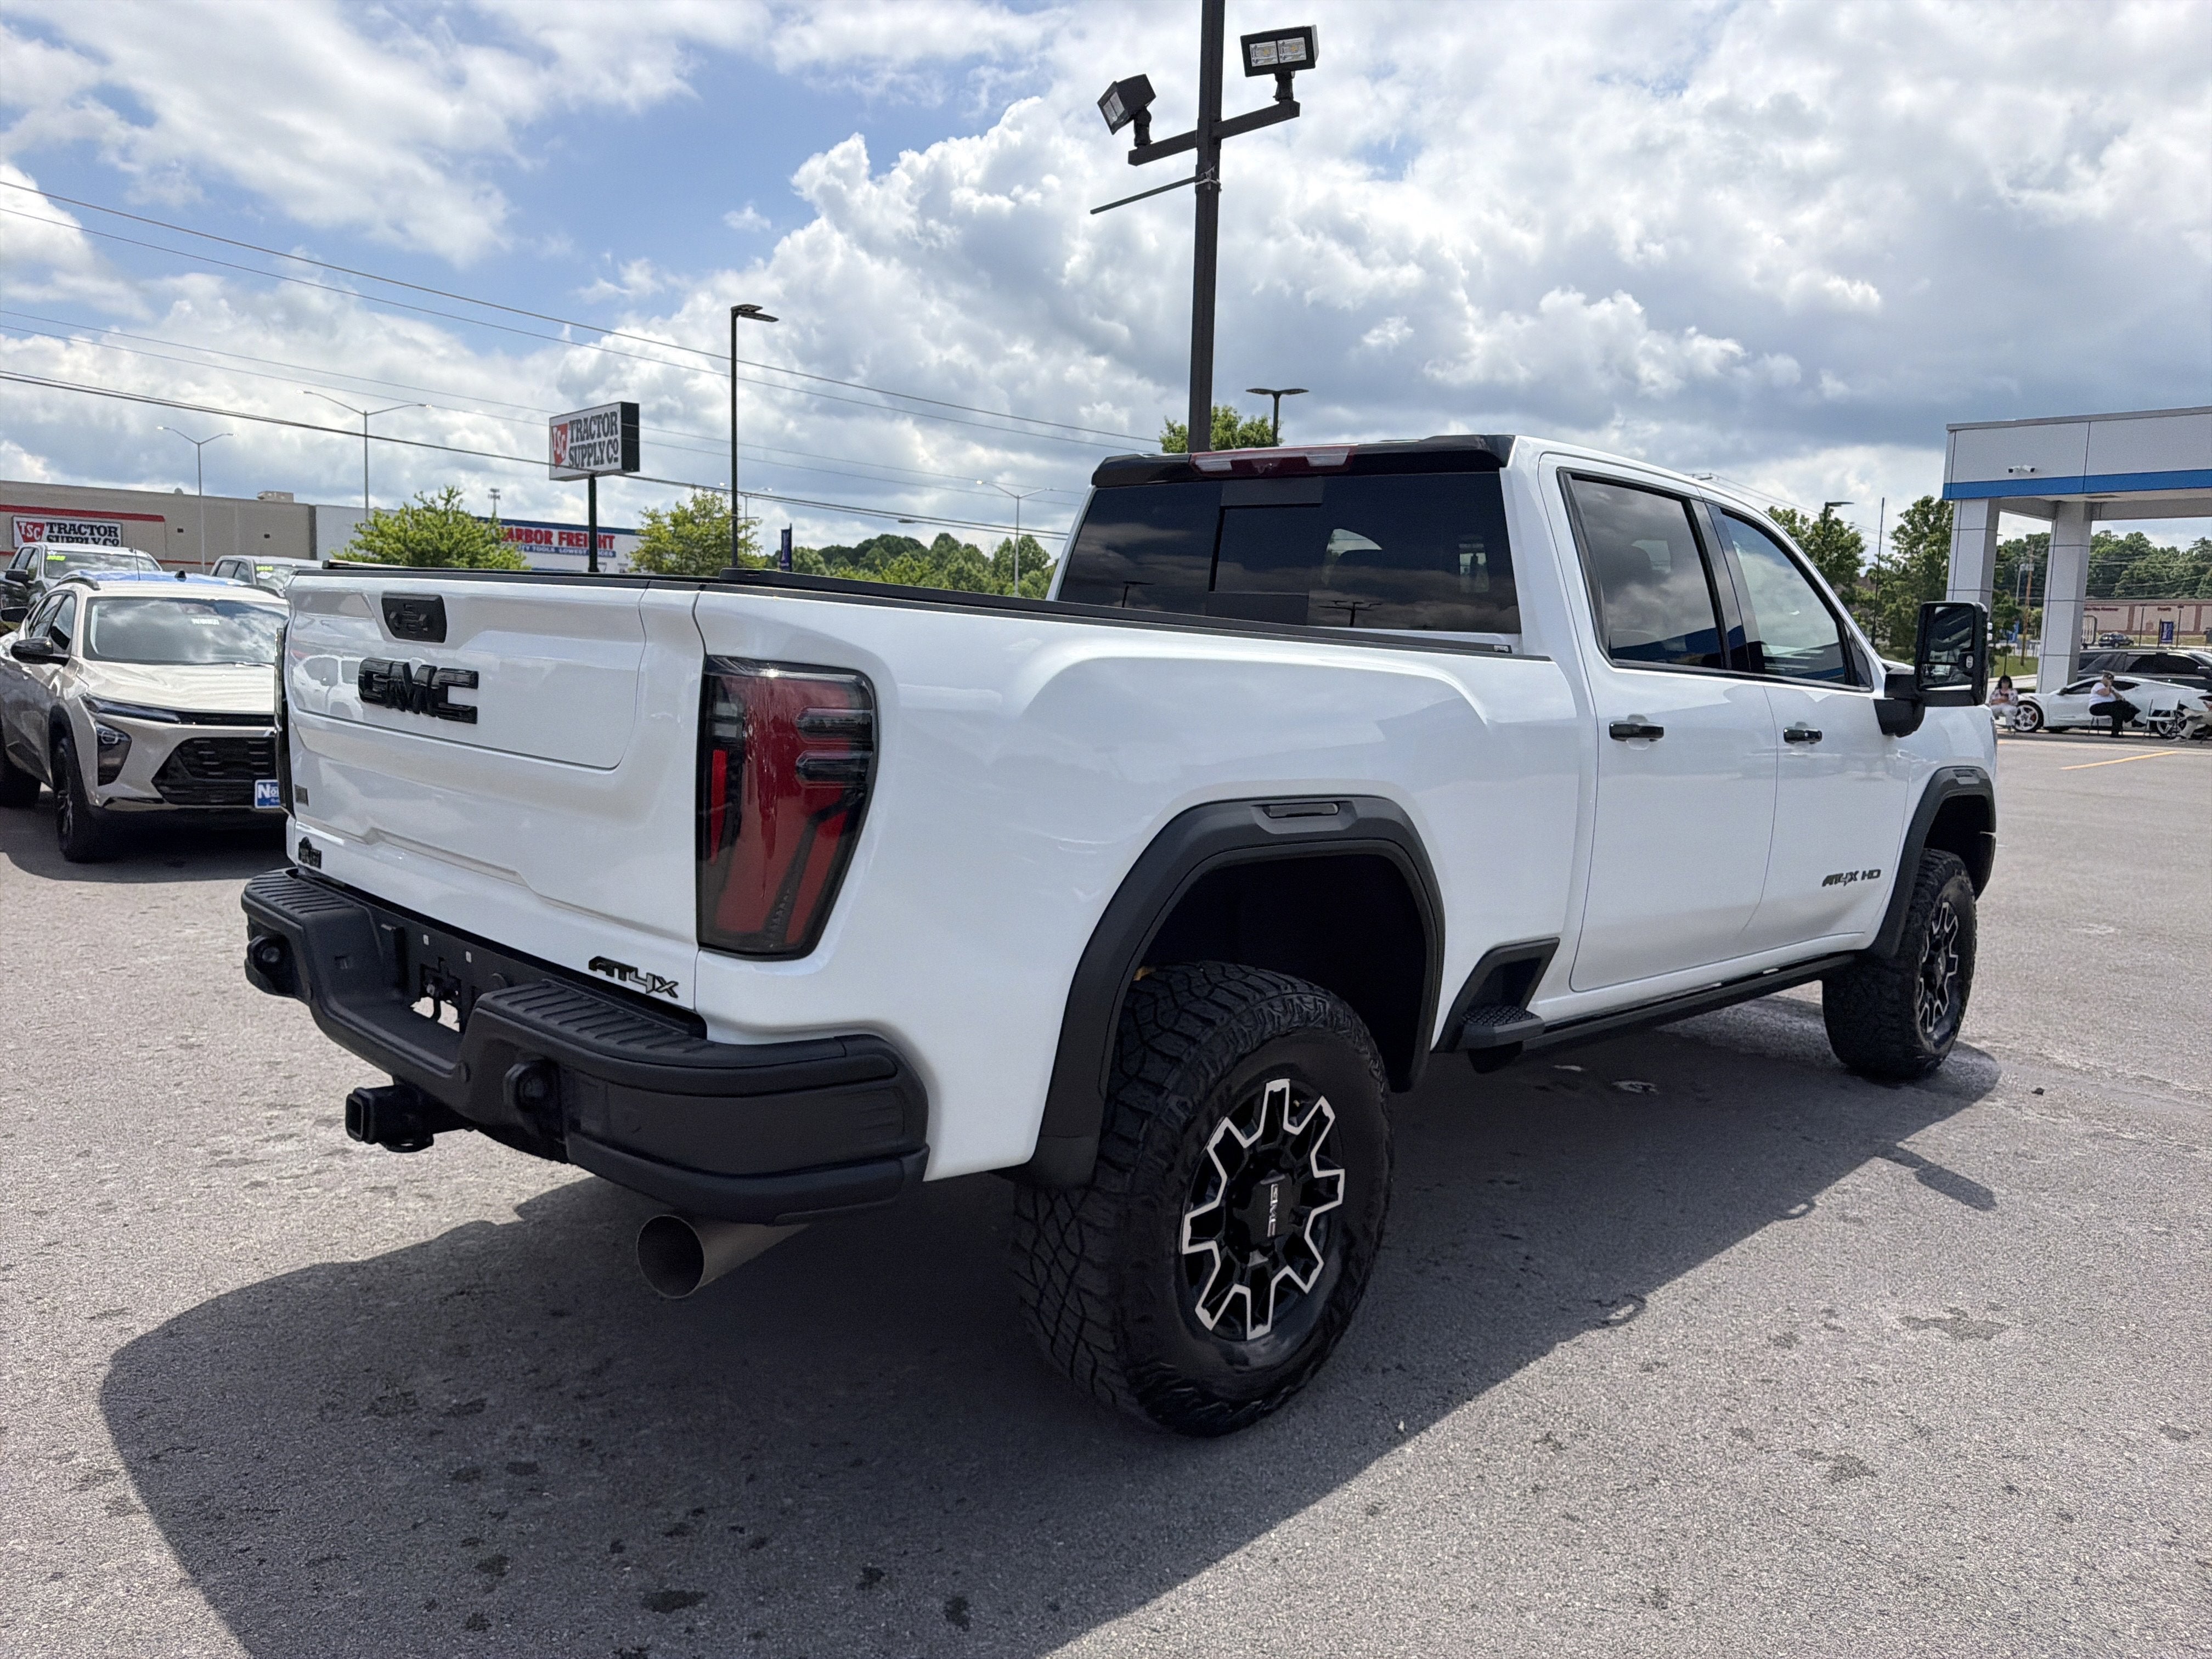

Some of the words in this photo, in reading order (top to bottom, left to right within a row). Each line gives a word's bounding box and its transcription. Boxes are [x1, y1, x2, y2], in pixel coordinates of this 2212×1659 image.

[569, 411, 619, 443] TRACTOR
[552, 426, 566, 459] TSC
[568, 440, 606, 467] SUPPLY
[19, 522, 41, 540] TSC
[46, 522, 119, 538] TRACTOR
[497, 527, 553, 545] ARBOR
[558, 531, 616, 550] FREIHT
[358, 657, 479, 724] GMC
[1822, 871, 1859, 887] AT4X
[1861, 869, 1882, 881] HD
[589, 956, 679, 999] AT4X
[1267, 1184, 1279, 1237] GMC
